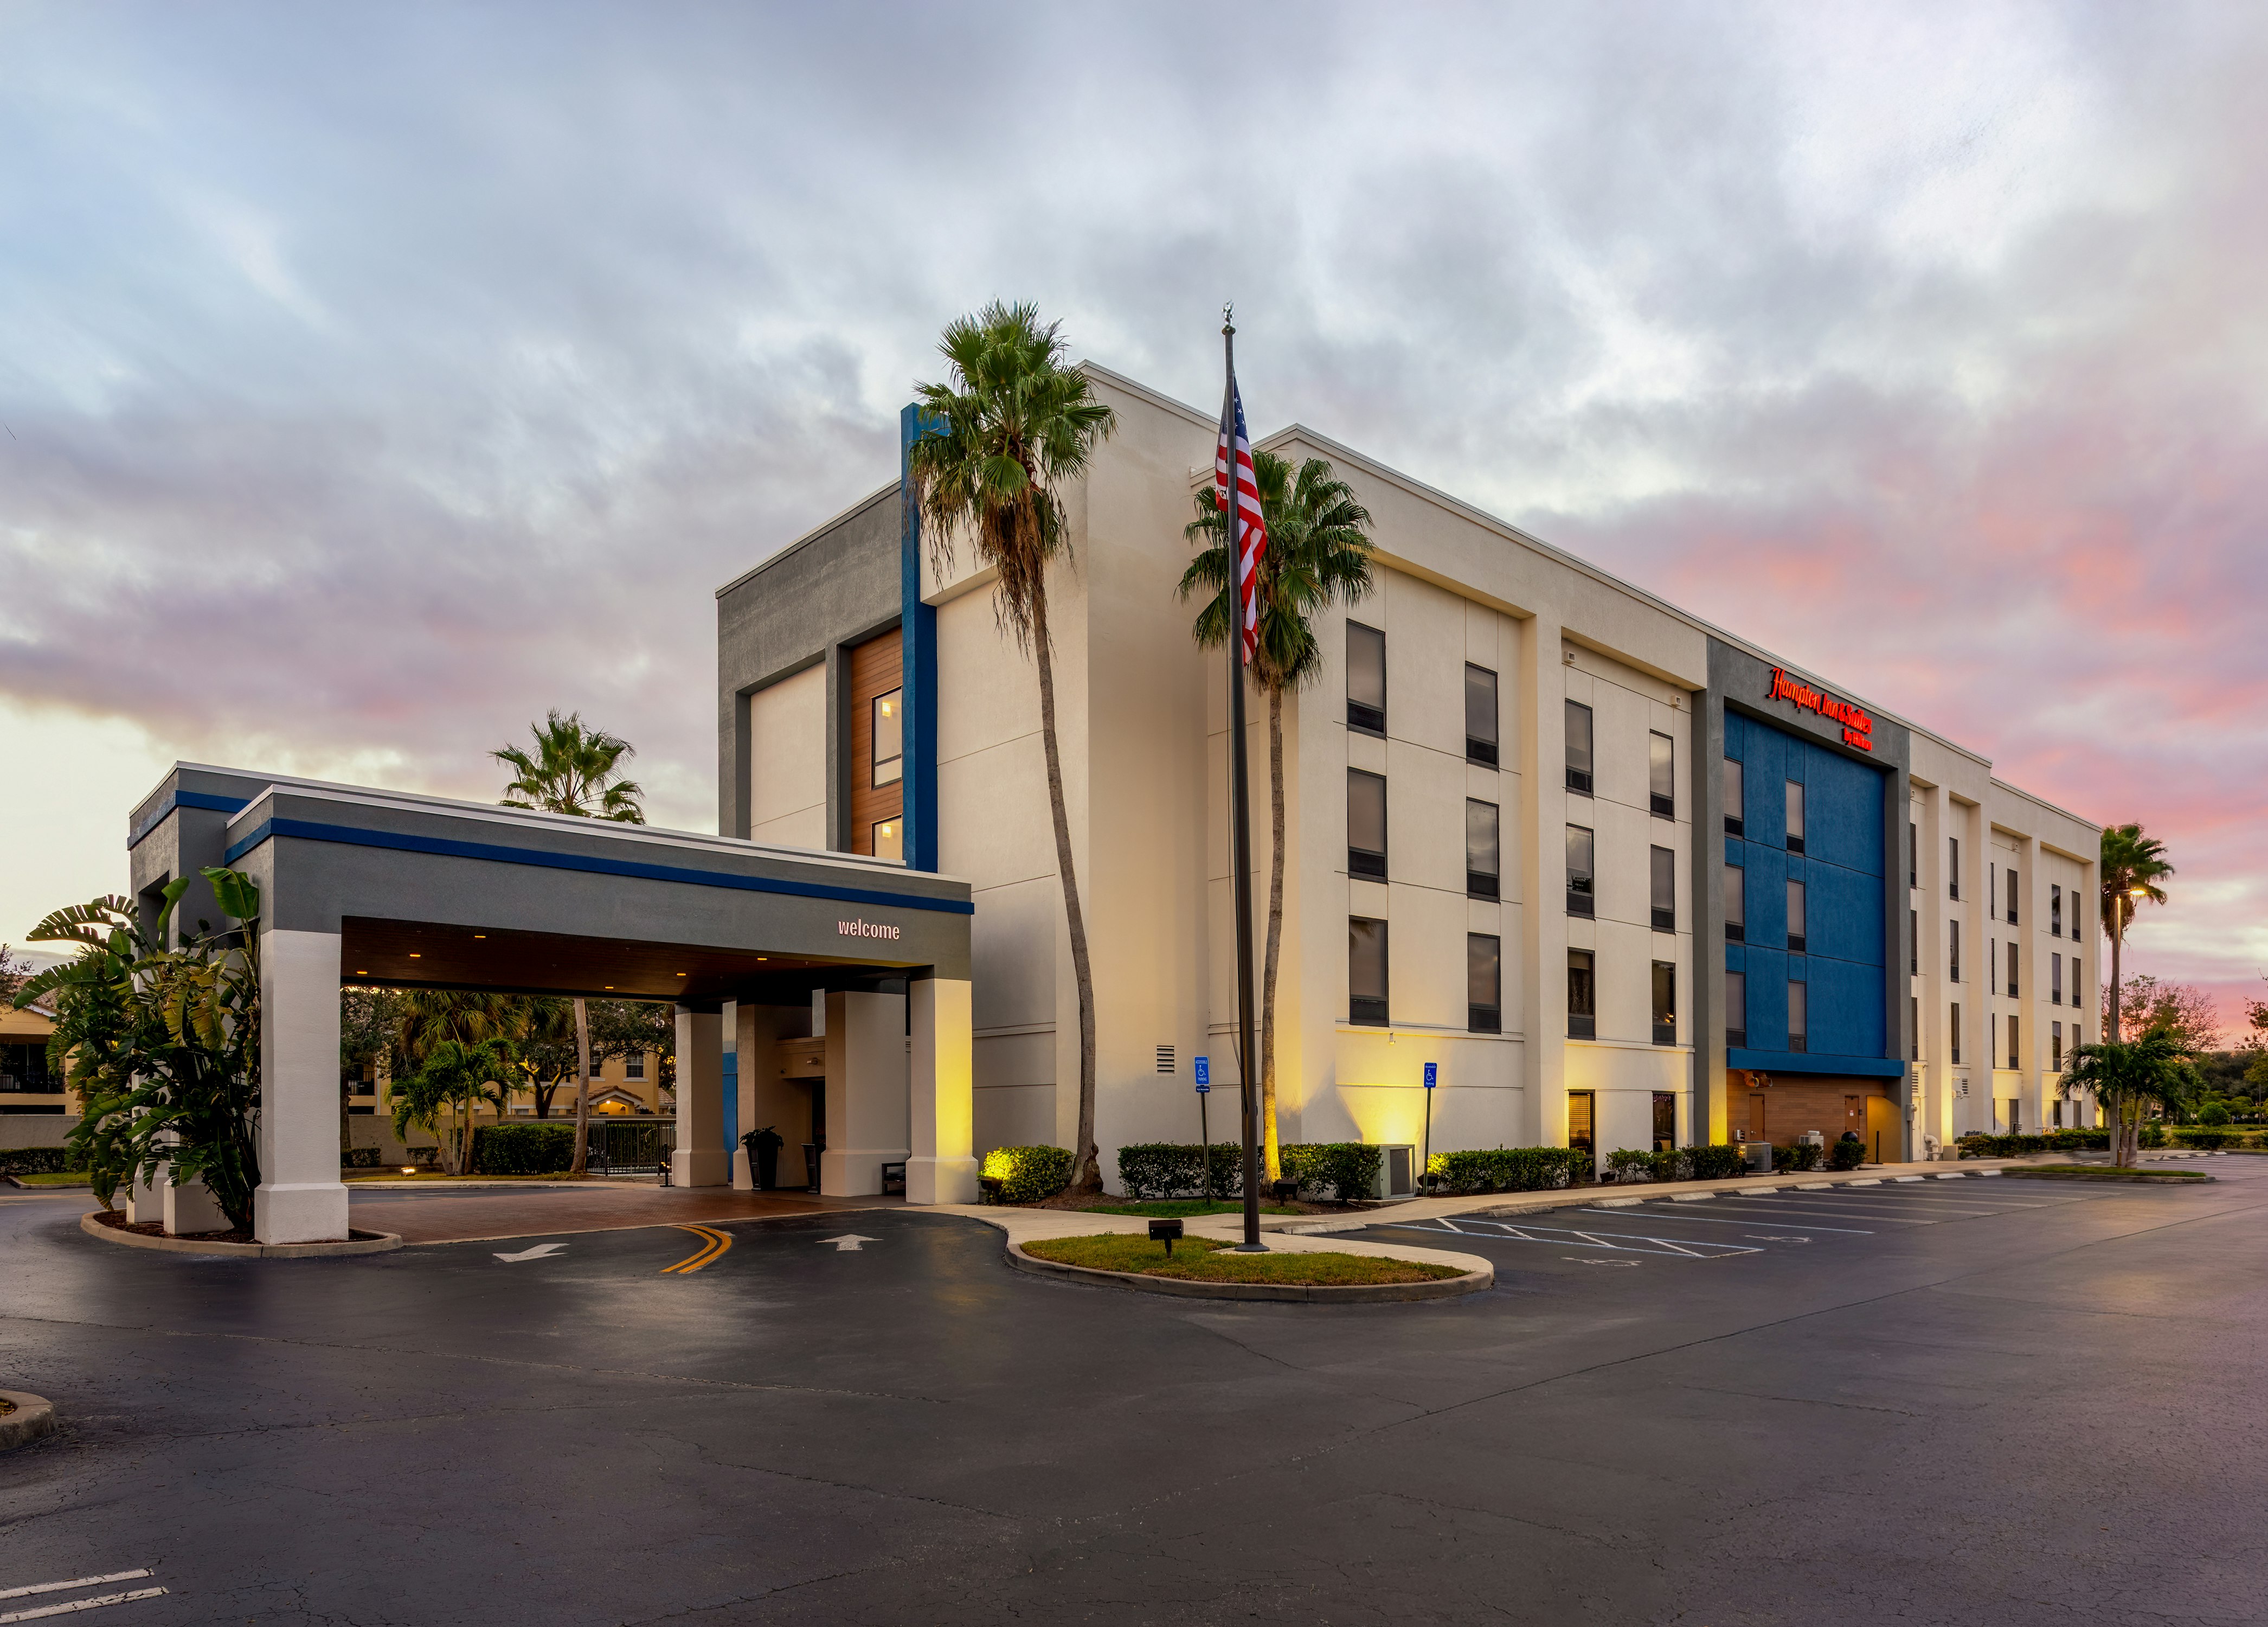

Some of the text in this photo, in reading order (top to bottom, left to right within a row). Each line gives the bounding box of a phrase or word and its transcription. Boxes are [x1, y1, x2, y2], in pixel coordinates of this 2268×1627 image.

[1769, 668, 1872, 734] Hampton Inn & Suites
[1844, 727, 1852, 745] by
[838, 918, 900, 940] welcome
